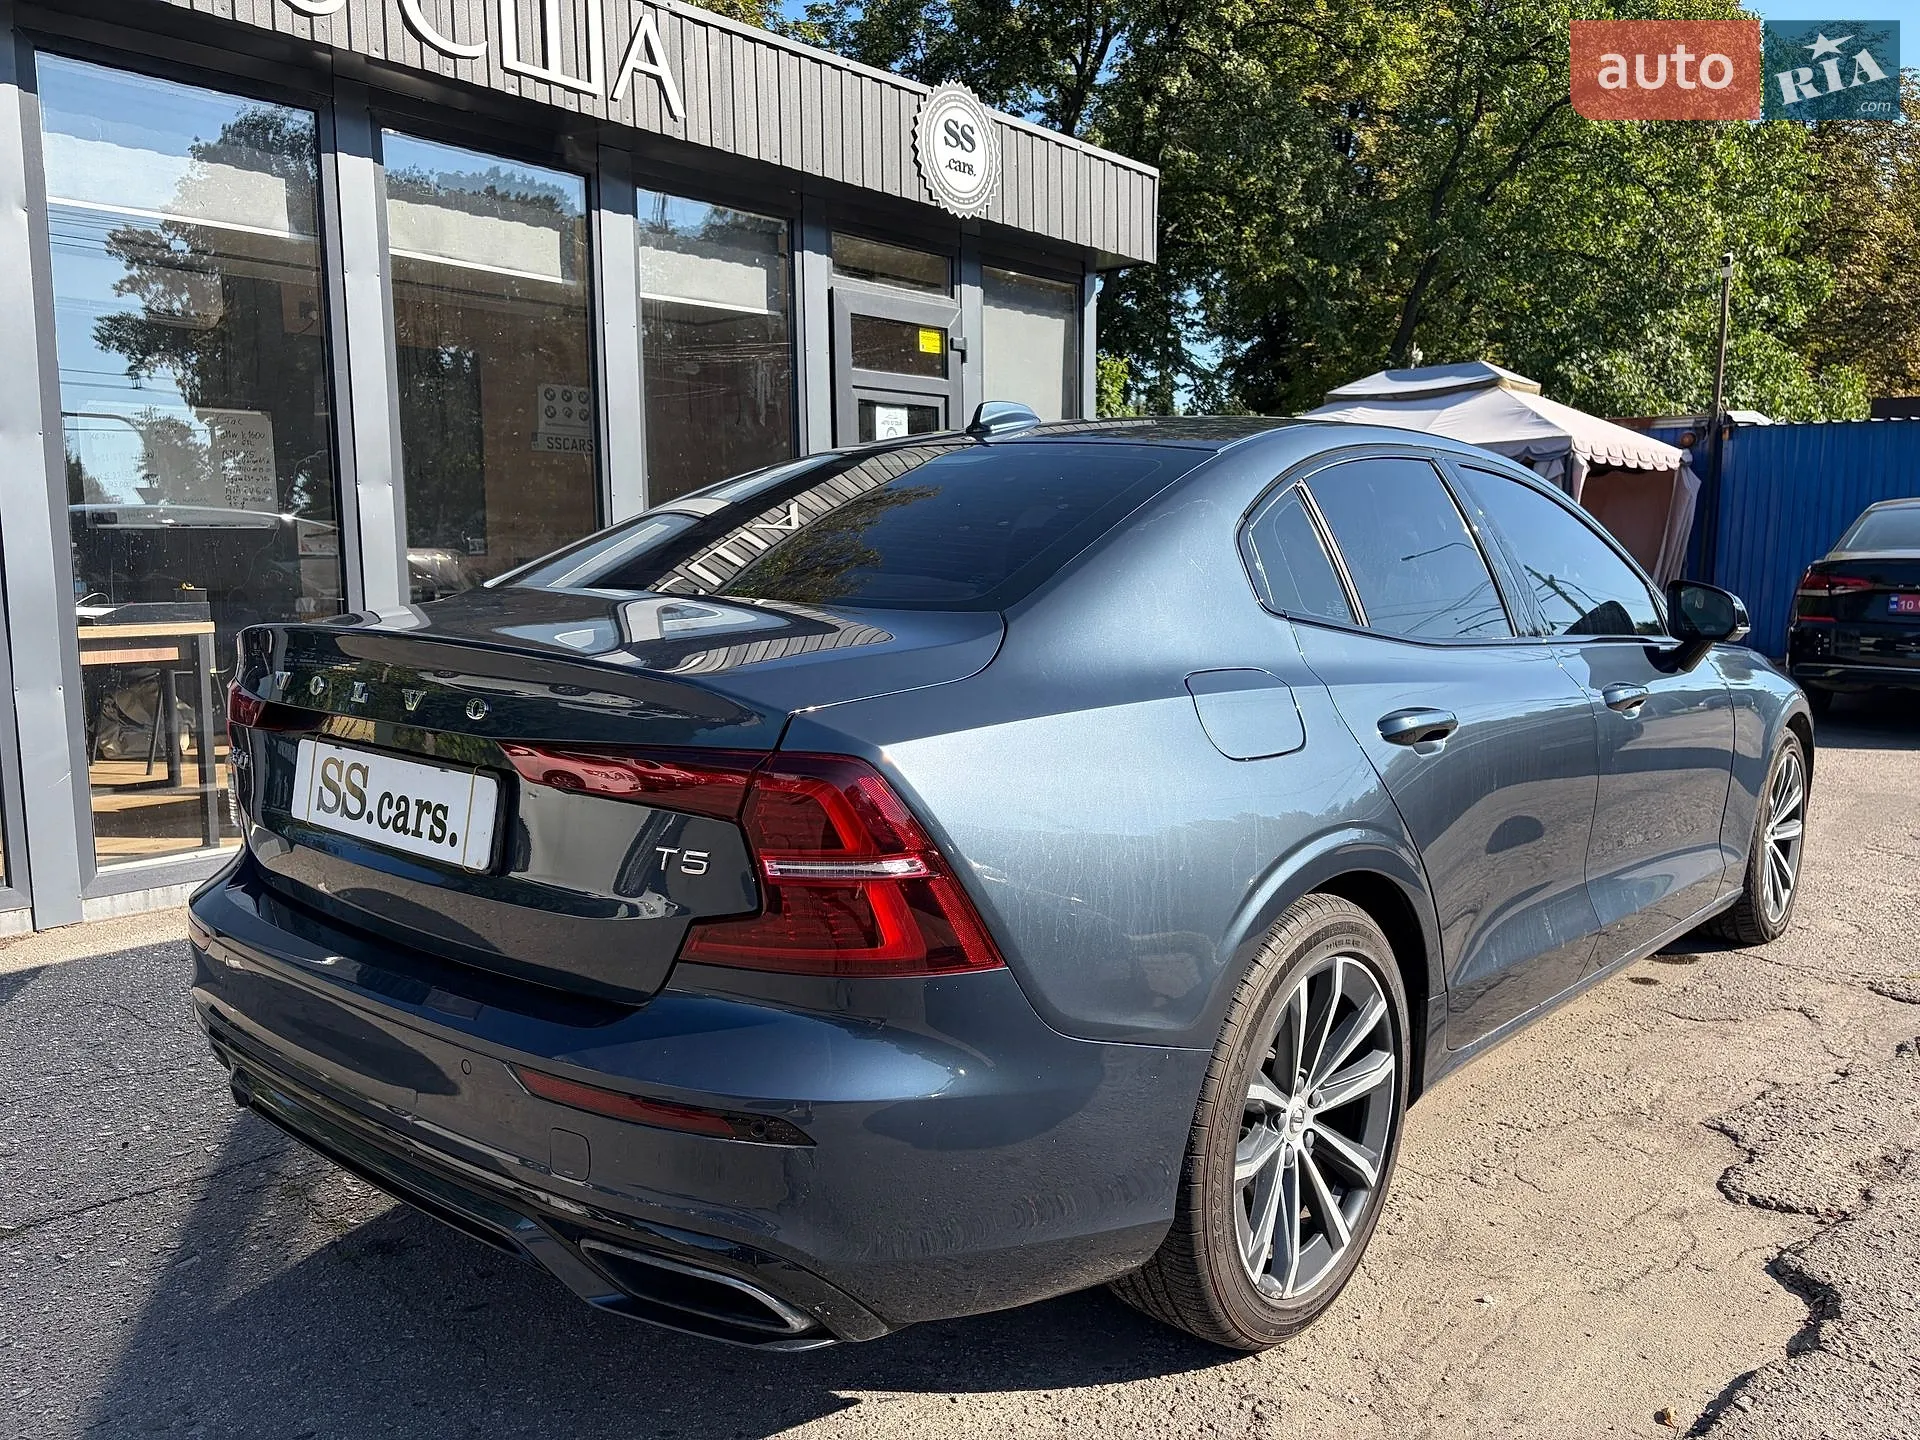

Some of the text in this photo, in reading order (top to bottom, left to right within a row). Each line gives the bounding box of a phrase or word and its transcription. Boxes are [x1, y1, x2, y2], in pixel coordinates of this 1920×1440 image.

[944, 119, 976, 153] SS
[547, 437, 593, 452] SSCARS
[275, 671, 488, 720] VOLVO
[656, 847, 710, 875] T5
